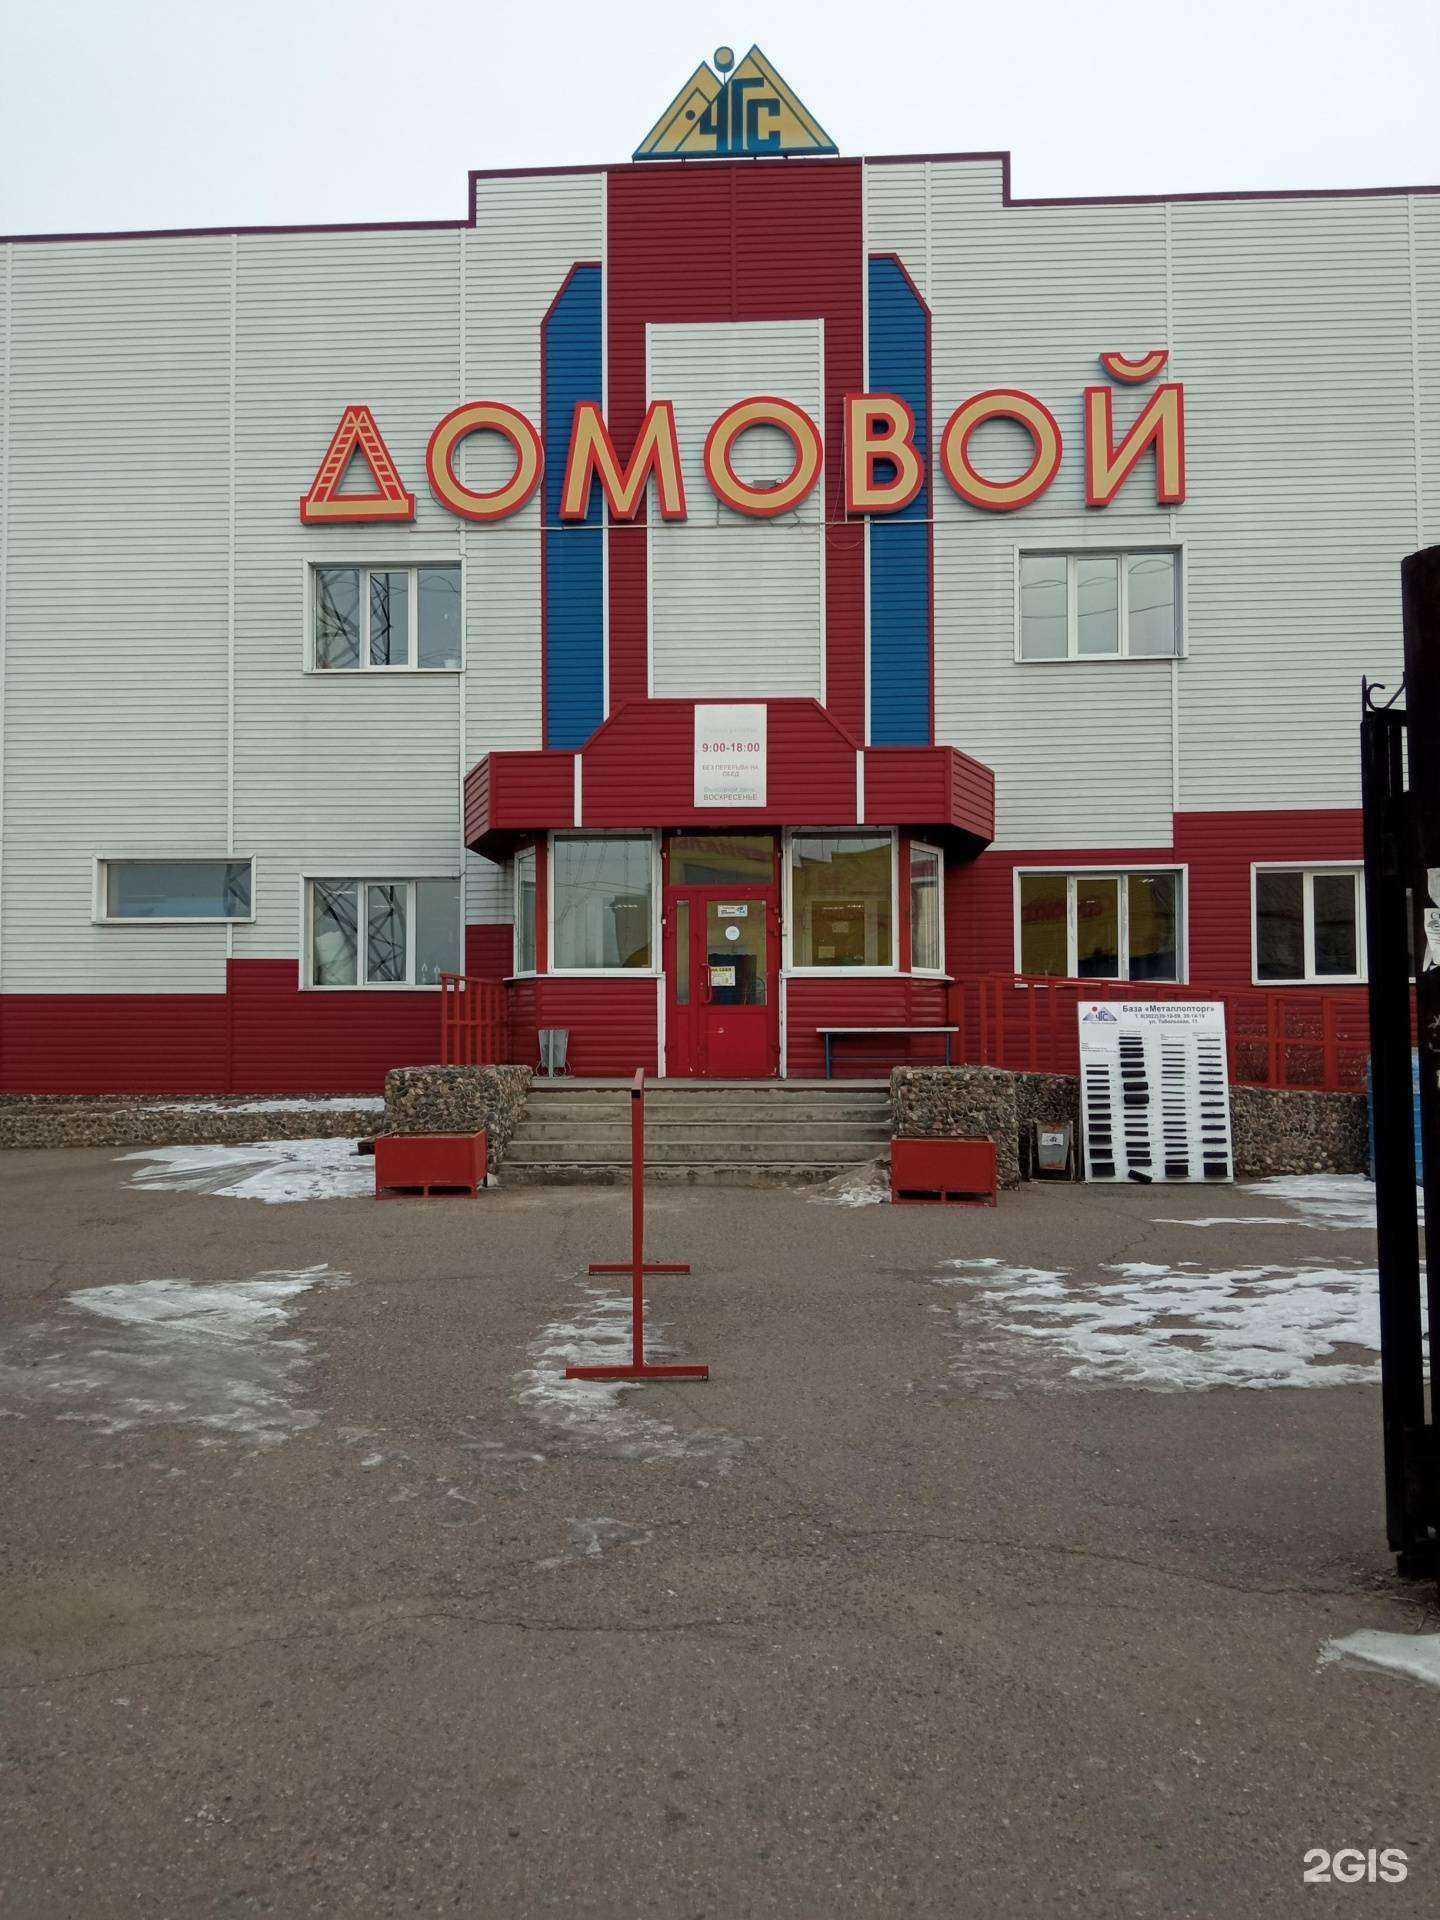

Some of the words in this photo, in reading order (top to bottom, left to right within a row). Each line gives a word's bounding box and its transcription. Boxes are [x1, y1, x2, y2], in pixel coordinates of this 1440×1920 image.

[300, 350, 1185, 524] ДОМОВОЙ
[702, 742, 760, 752] 9:00-18:00
[1122, 1005, 1143, 1013] База
[1145, 1005, 1215, 1013] «Металлопторг»
